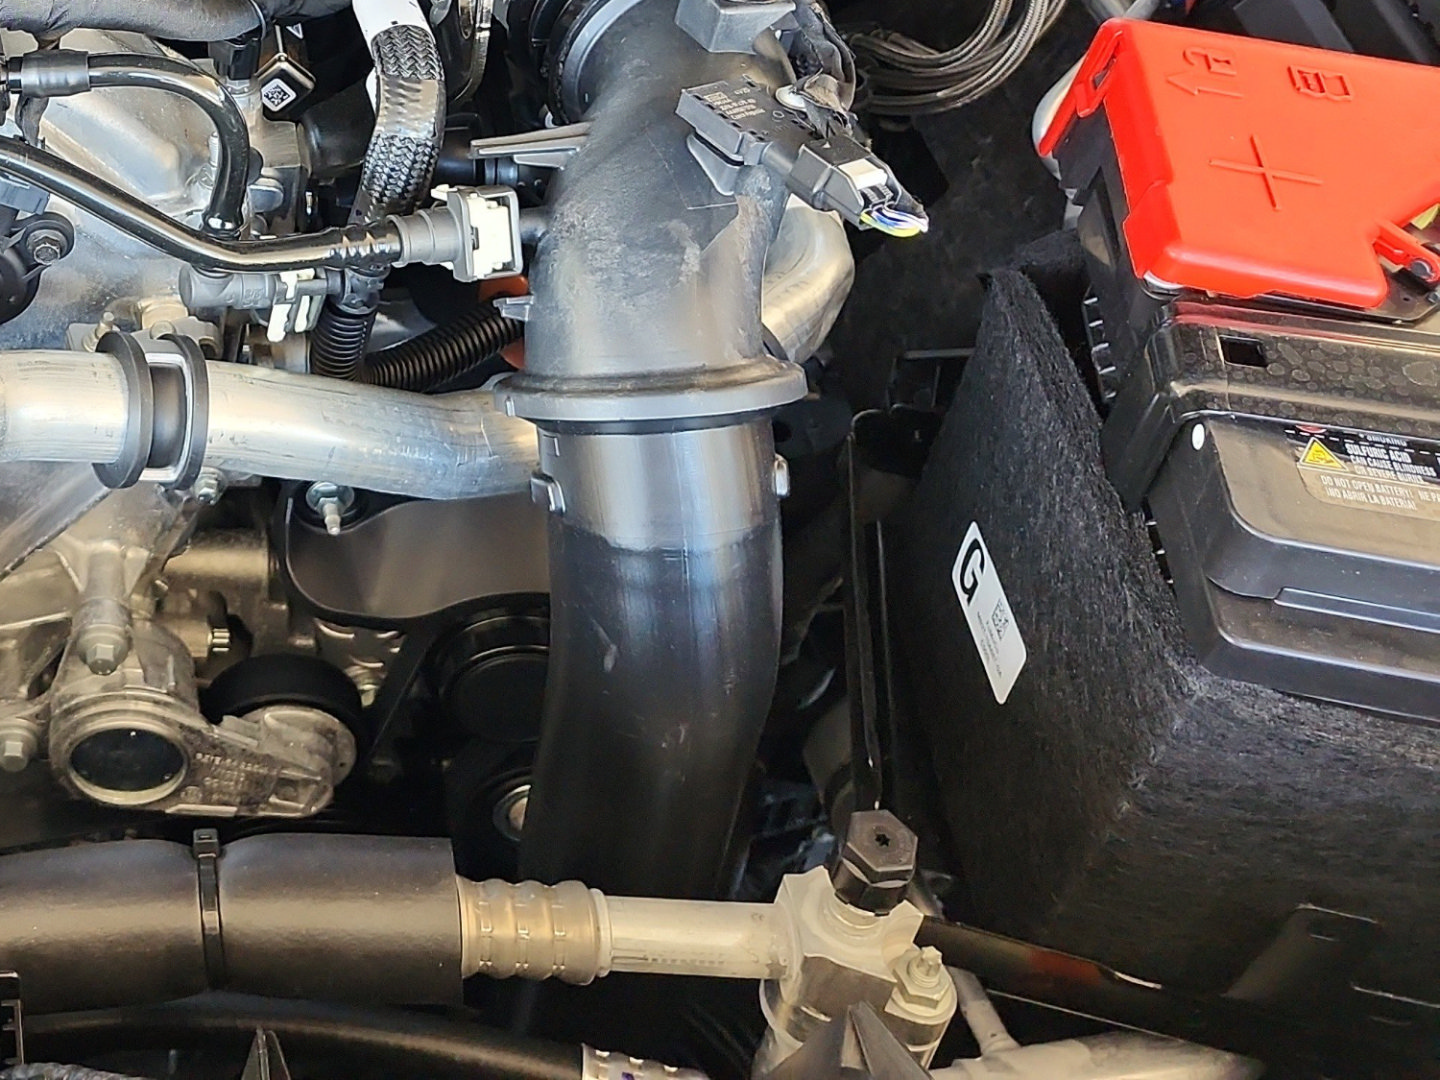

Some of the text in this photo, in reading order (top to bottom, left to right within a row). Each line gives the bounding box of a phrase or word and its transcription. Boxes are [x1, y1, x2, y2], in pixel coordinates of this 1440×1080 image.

[1345, 443, 1412, 463] SULFURIC ACID
[1349, 454, 1368, 466] CAN
[1366, 456, 1394, 471] CAUSE
[1392, 461, 1438, 478] BLINDNESS
[1321, 475, 1334, 485] DO
[1335, 477, 1351, 489] NOT
[1352, 479, 1376, 493] OPEN
[1342, 490, 1368, 503] ABRIR
[1367, 494, 1381, 506] LA
[960, 537, 986, 607] G
